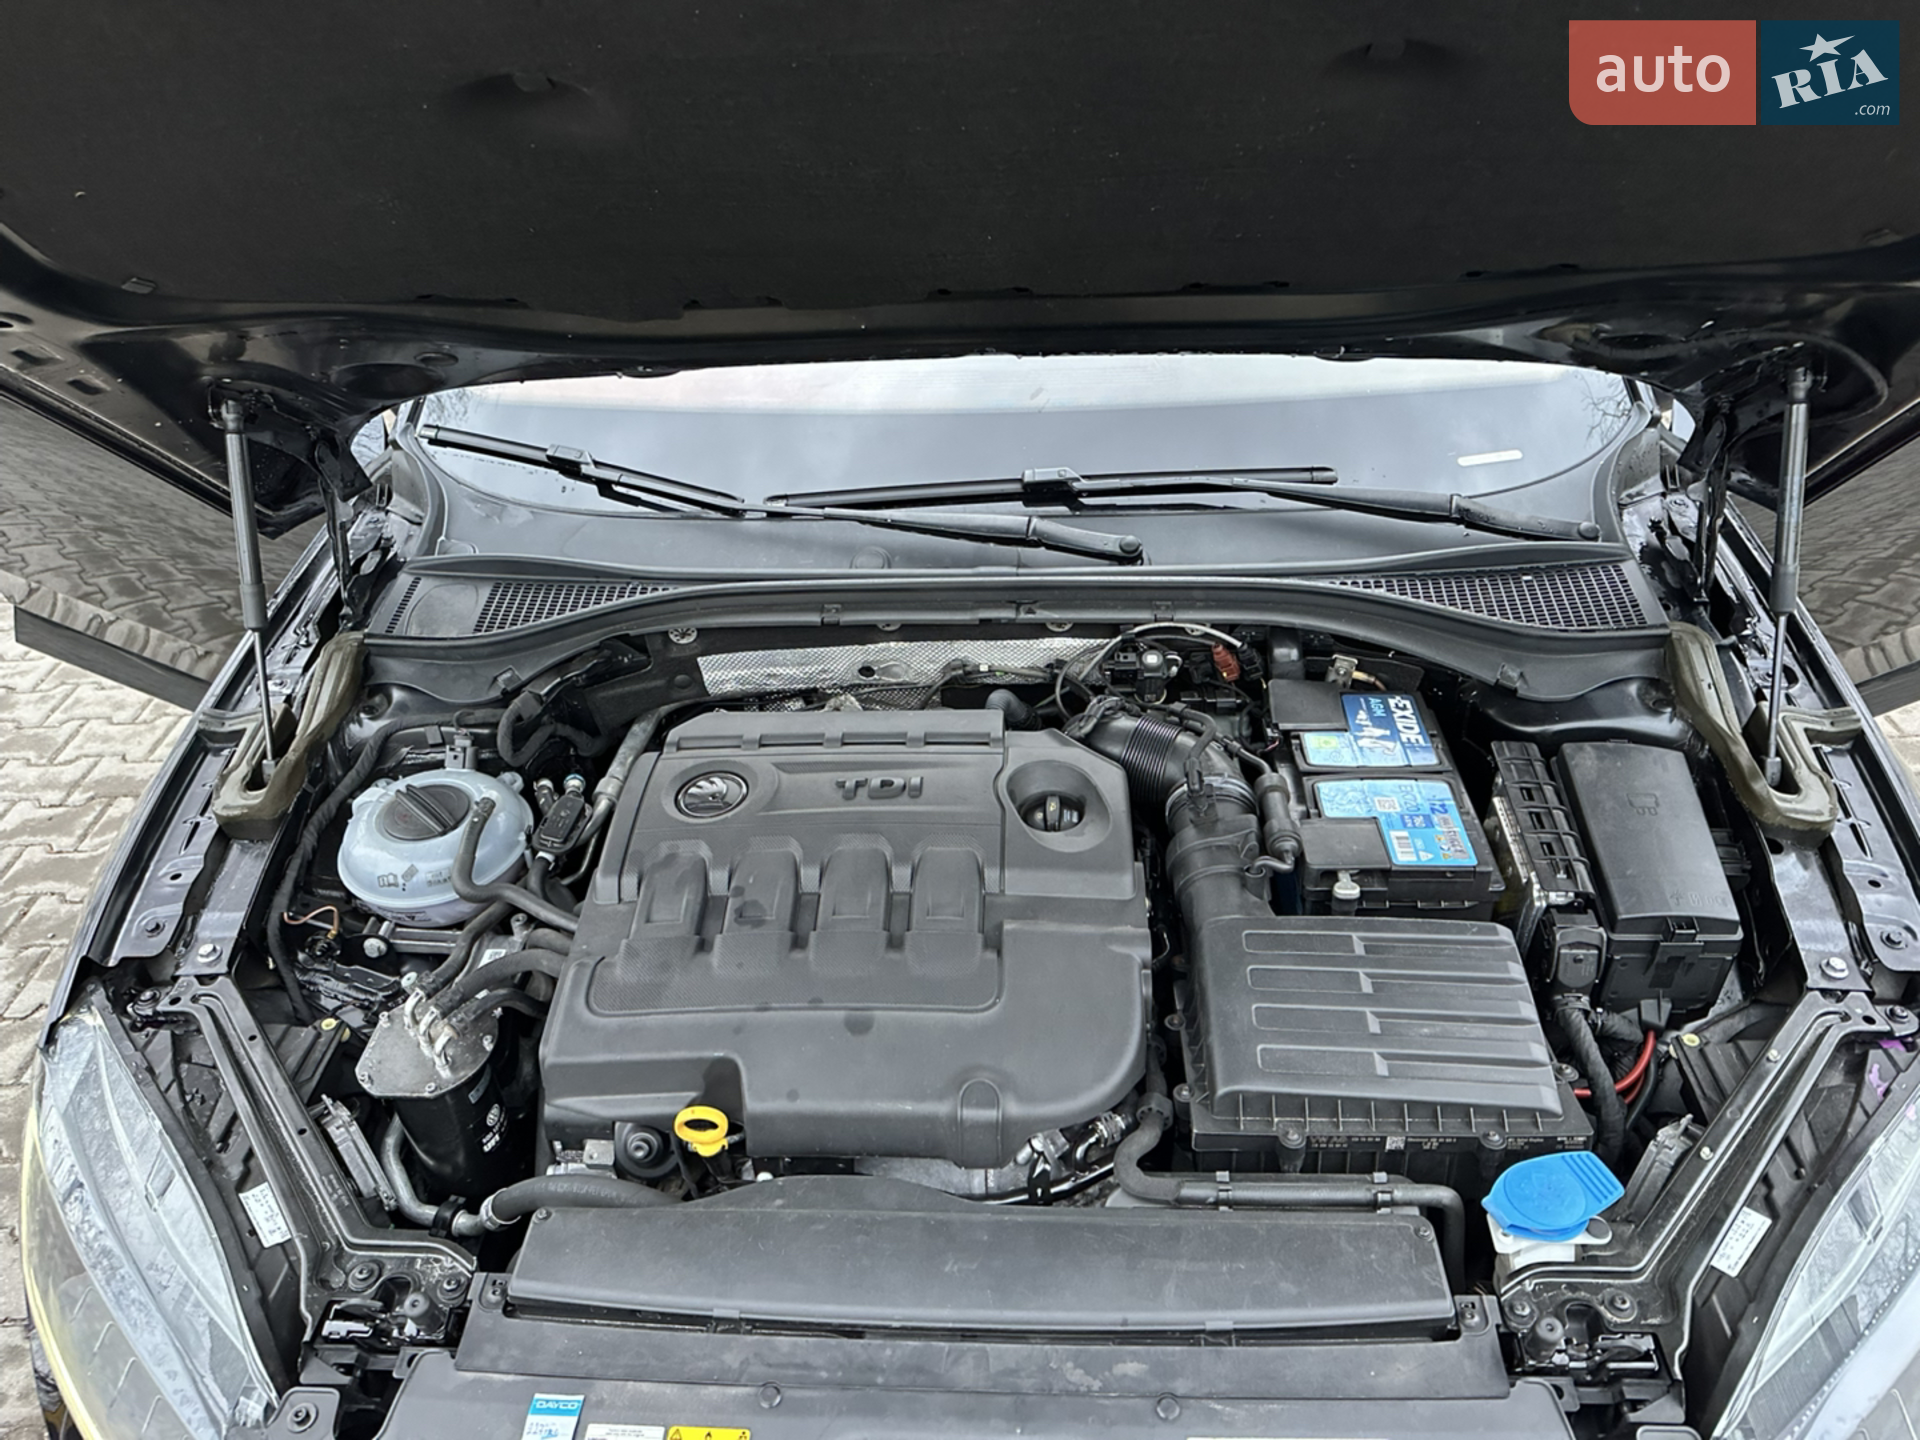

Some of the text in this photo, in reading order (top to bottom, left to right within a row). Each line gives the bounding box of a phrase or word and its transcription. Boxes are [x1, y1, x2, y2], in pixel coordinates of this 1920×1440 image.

[1368, 697, 1387, 717] AGM
[1387, 696, 1426, 747] EXIDE
[835, 776, 924, 800] TDI
[535, 1400, 578, 1410] DAYCO
